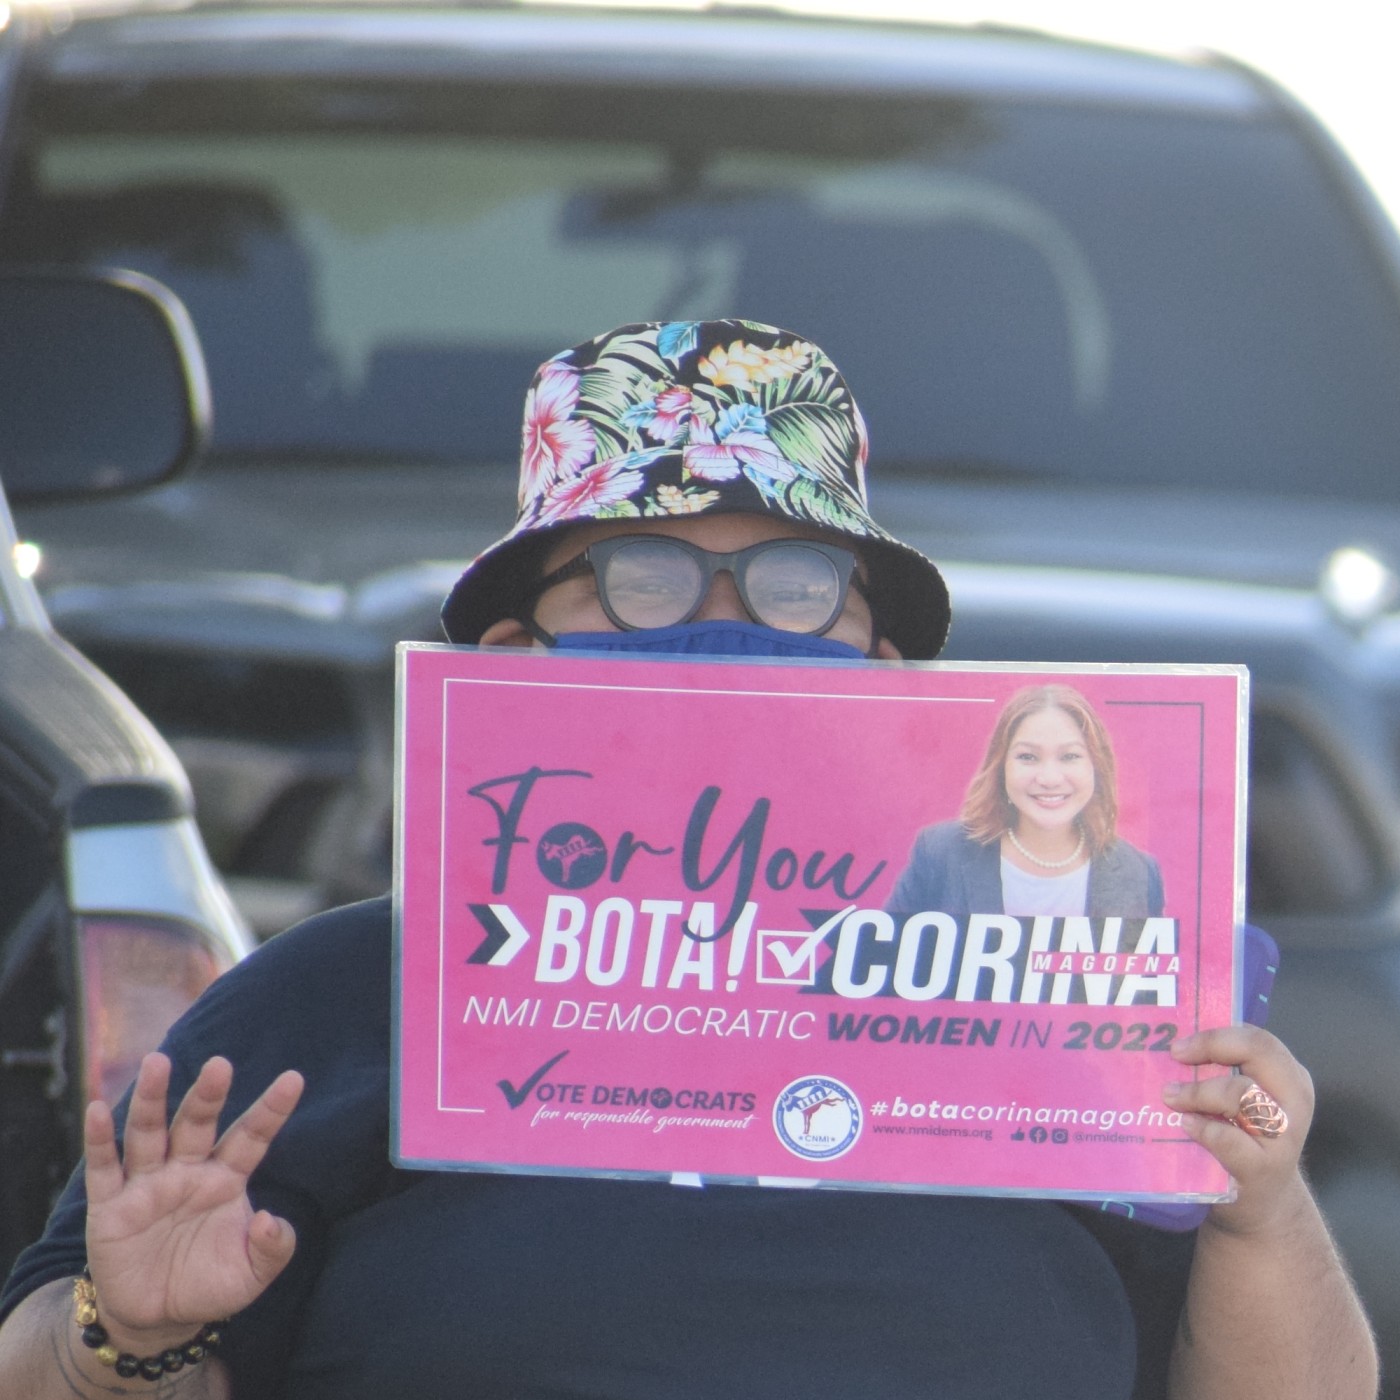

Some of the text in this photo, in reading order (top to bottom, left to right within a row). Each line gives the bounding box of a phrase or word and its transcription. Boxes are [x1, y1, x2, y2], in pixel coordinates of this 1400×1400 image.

[467, 765, 887, 943] For You
[534, 894, 1177, 1007] BOTA! CORINA
[1033, 953, 1181, 973] MAGOFNA
[463, 995, 1178, 1052] NMI DEMOCRATIC WOMEN IN 2022
[590, 1084, 757, 1112] DEMOCRATS
[530, 1104, 760, 1133] for responsible government
[870, 1096, 1183, 1131] #botacorinamagofna
[804, 1134, 831, 1144] CNMI
[872, 1123, 1146, 1144] www.nmidems.org @nmidems
